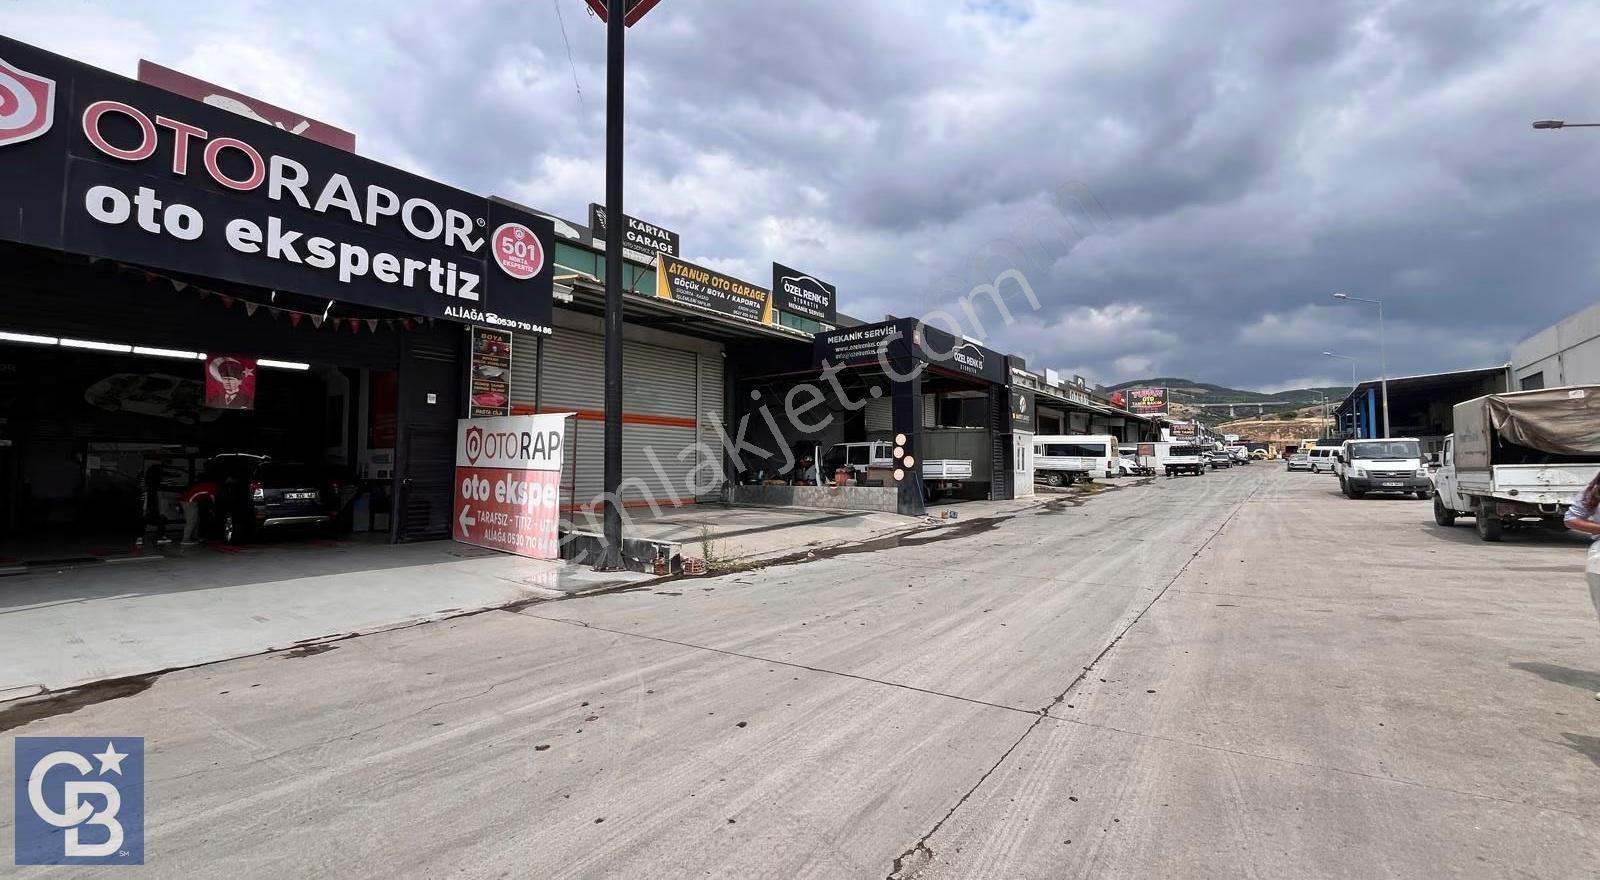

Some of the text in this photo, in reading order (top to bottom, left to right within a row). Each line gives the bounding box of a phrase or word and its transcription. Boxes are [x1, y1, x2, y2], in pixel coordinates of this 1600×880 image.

[629, 218, 671, 241] KARTAL
[85, 185, 481, 301] oto ekspertiz
[502, 237, 535, 261] 501
[626, 231, 673, 254] GARAGE
[668, 262, 766, 302] ATANUR OTO GARAGE
[674, 277, 700, 292] GÖÇÜK
[707, 288, 725, 299] BOYA
[732, 295, 761, 309] KAPORTA
[784, 281, 803, 297] ÖZEL
[803, 289, 822, 304] RENK
[444, 306, 485, 322] ALİAĞA
[496, 317, 517, 328] 0530
[517, 321, 531, 331] 710
[532, 324, 543, 333] 84
[827, 324, 896, 345] MEKANİK SERVİSİ
[461, 474, 490, 502] oto
[507, 532, 524, 547] 0530
